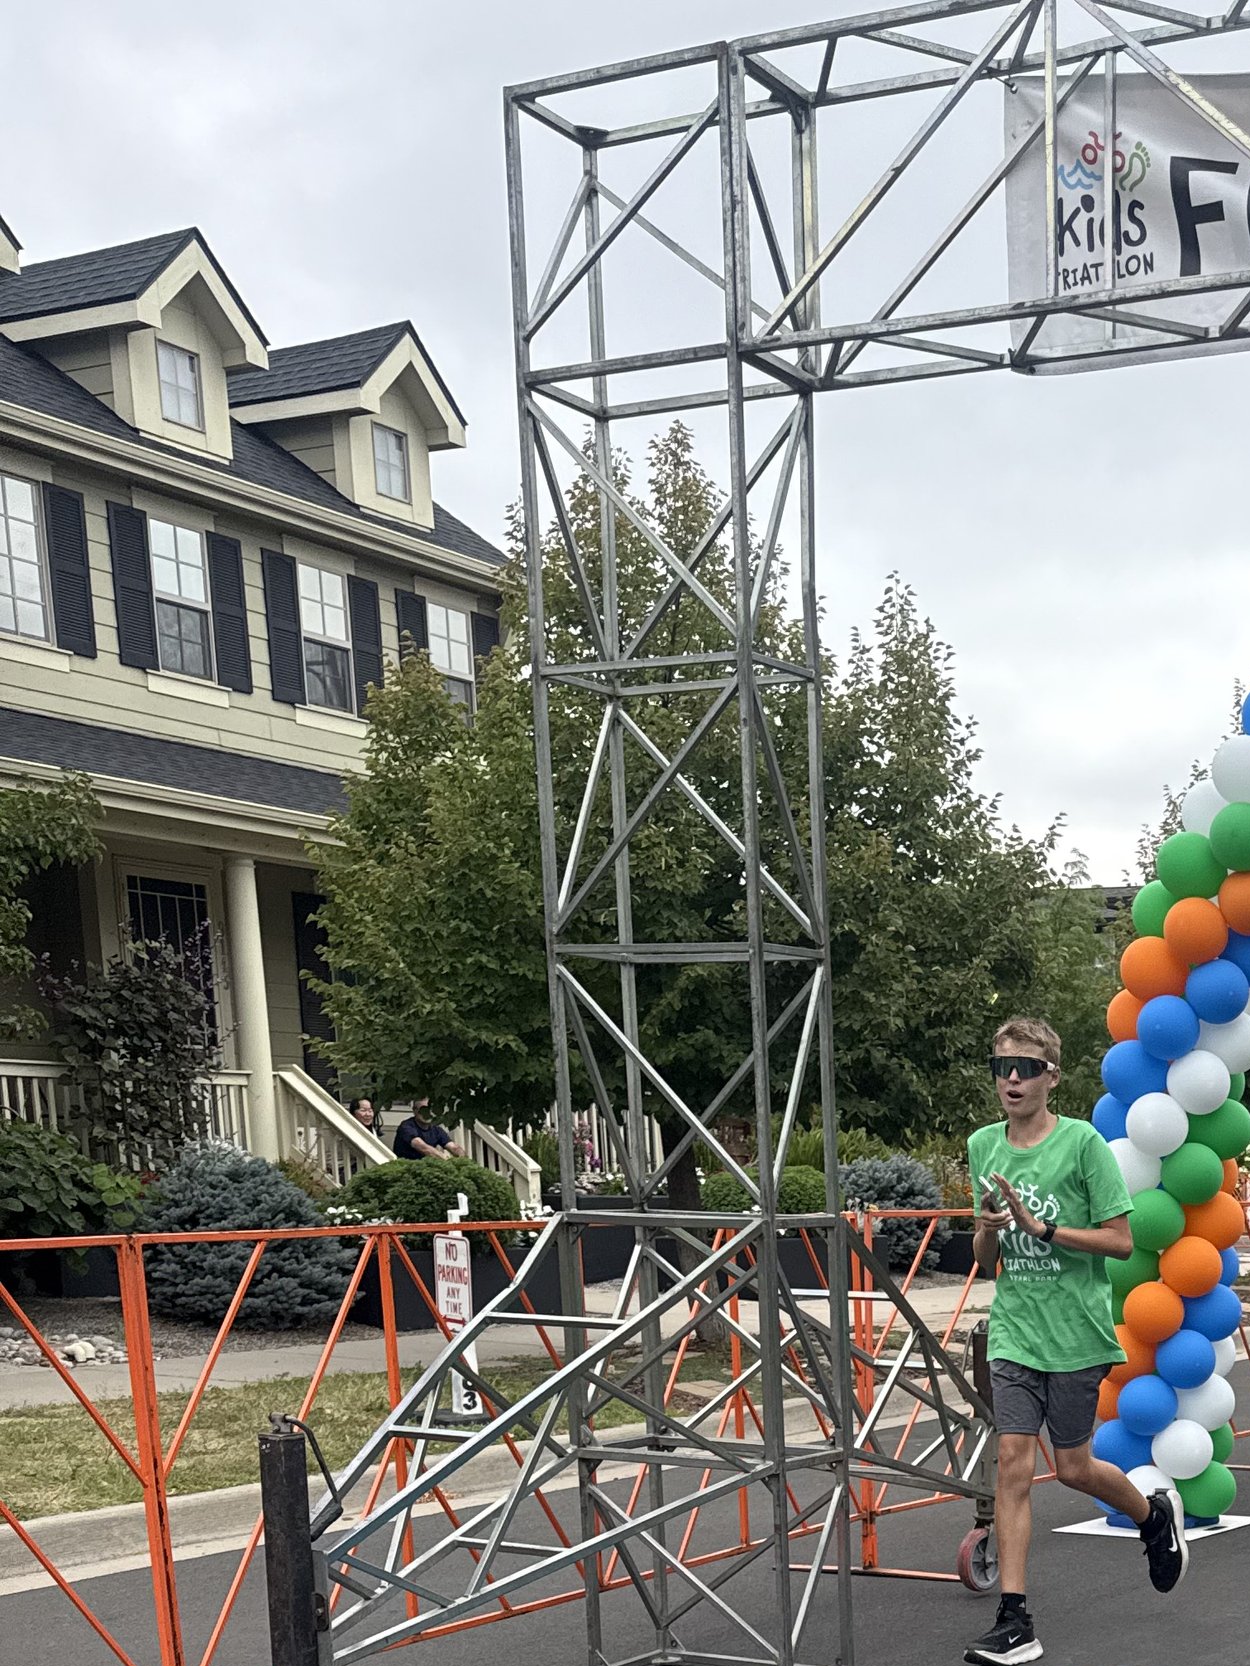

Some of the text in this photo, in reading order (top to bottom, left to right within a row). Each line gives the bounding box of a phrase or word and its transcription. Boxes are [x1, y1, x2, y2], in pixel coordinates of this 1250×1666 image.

[1057, 190, 1147, 257] kids
[1058, 252, 1154, 290] RIATLON
[445, 1241, 458, 1262] NO
[437, 1263, 468, 1286] PARKING
[1003, 1257, 1061, 1272] IATHLON
[446, 1286, 460, 1299] ANY
[445, 1300, 462, 1315] TIME
